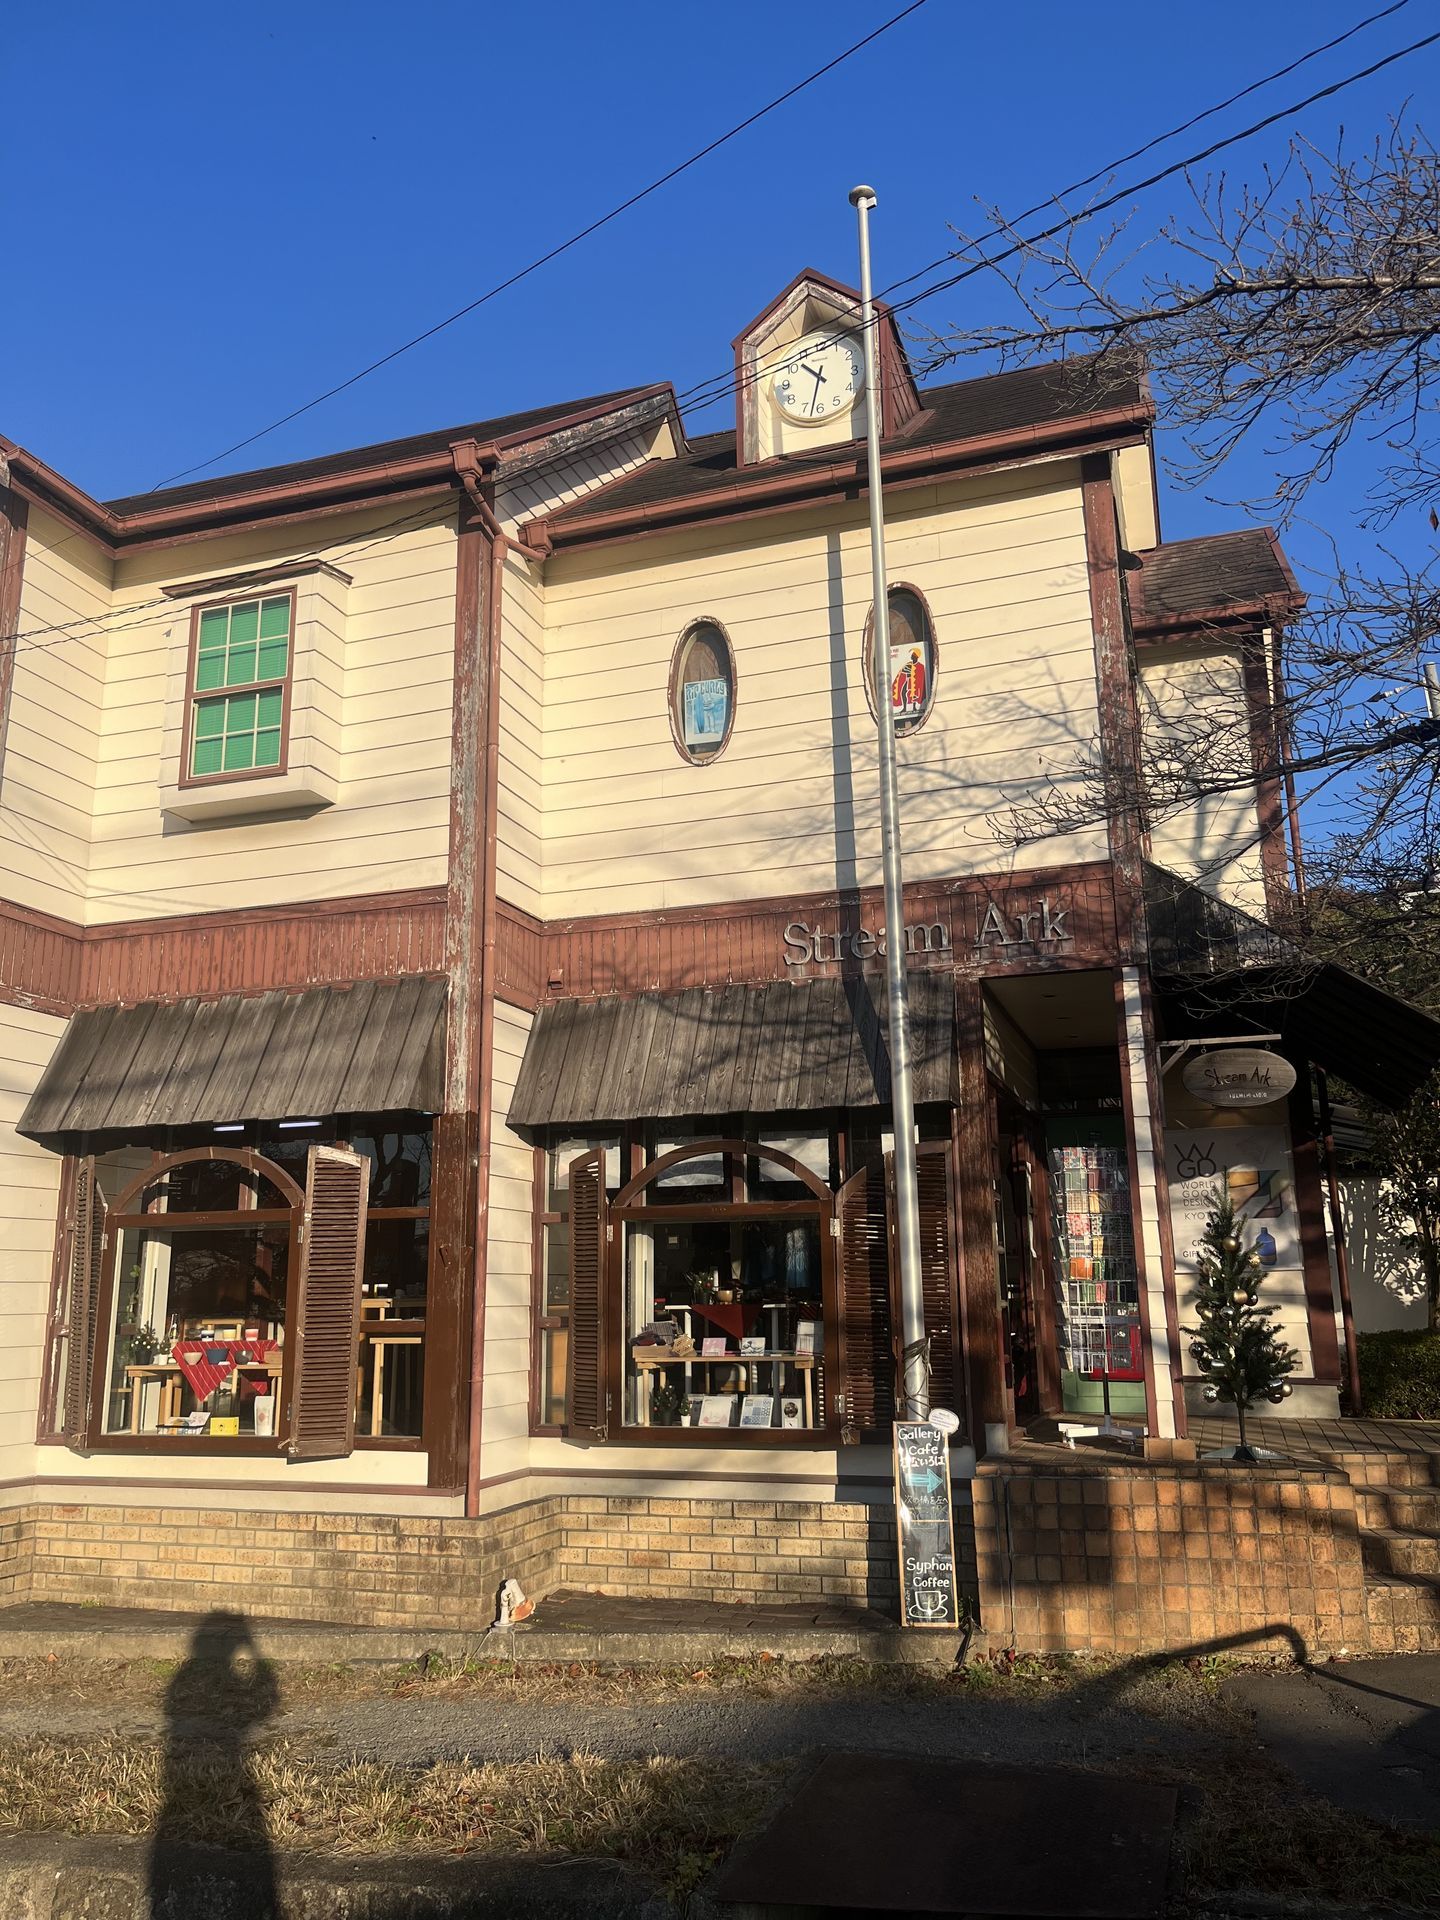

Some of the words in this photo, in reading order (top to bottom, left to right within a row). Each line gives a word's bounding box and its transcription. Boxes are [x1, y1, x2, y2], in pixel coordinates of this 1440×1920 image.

[845, 350, 853, 360] 2
[787, 364, 799, 374] 10
[851, 366, 859, 375] 3
[782, 380, 790, 390] 9
[845, 383, 853, 391] 4
[787, 395, 796, 404] 8
[833, 396, 841, 406] 5
[801, 403, 809, 413] 7
[816, 403, 825, 413] 6
[973, 898, 1073, 949] Ark
[1250, 1066, 1272, 1087] Ark
[1181, 1181, 1215, 1189] WORLD
[898, 1428, 940, 1441] Gallery
[909, 1443, 939, 1455] Cafe
[907, 1557, 952, 1574] Syphon
[913, 1577, 949, 1587] Coffee
